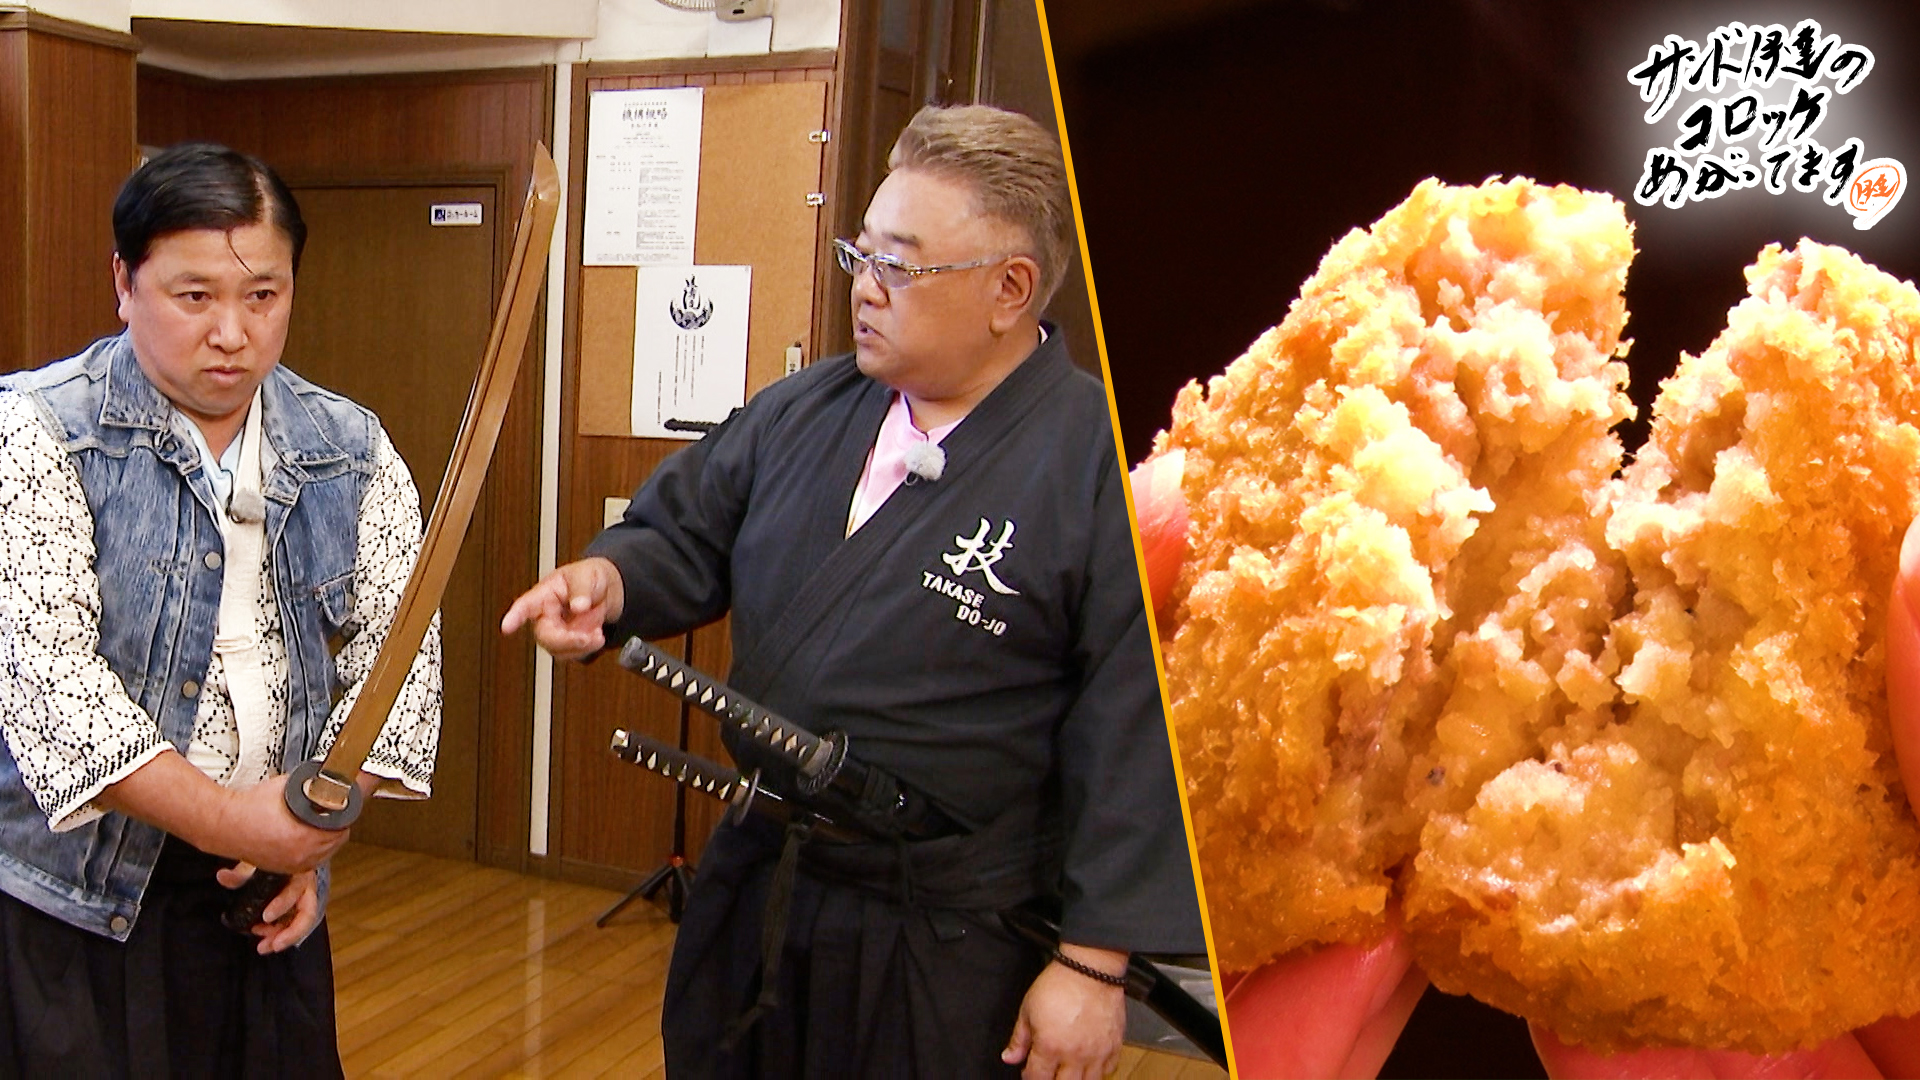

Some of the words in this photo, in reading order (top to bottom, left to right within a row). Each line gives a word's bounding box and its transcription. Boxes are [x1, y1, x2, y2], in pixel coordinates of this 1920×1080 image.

[942, 517, 1021, 595] 技
[922, 571, 985, 608] TAKASE
[956, 605, 1007, 636] DO-JO
